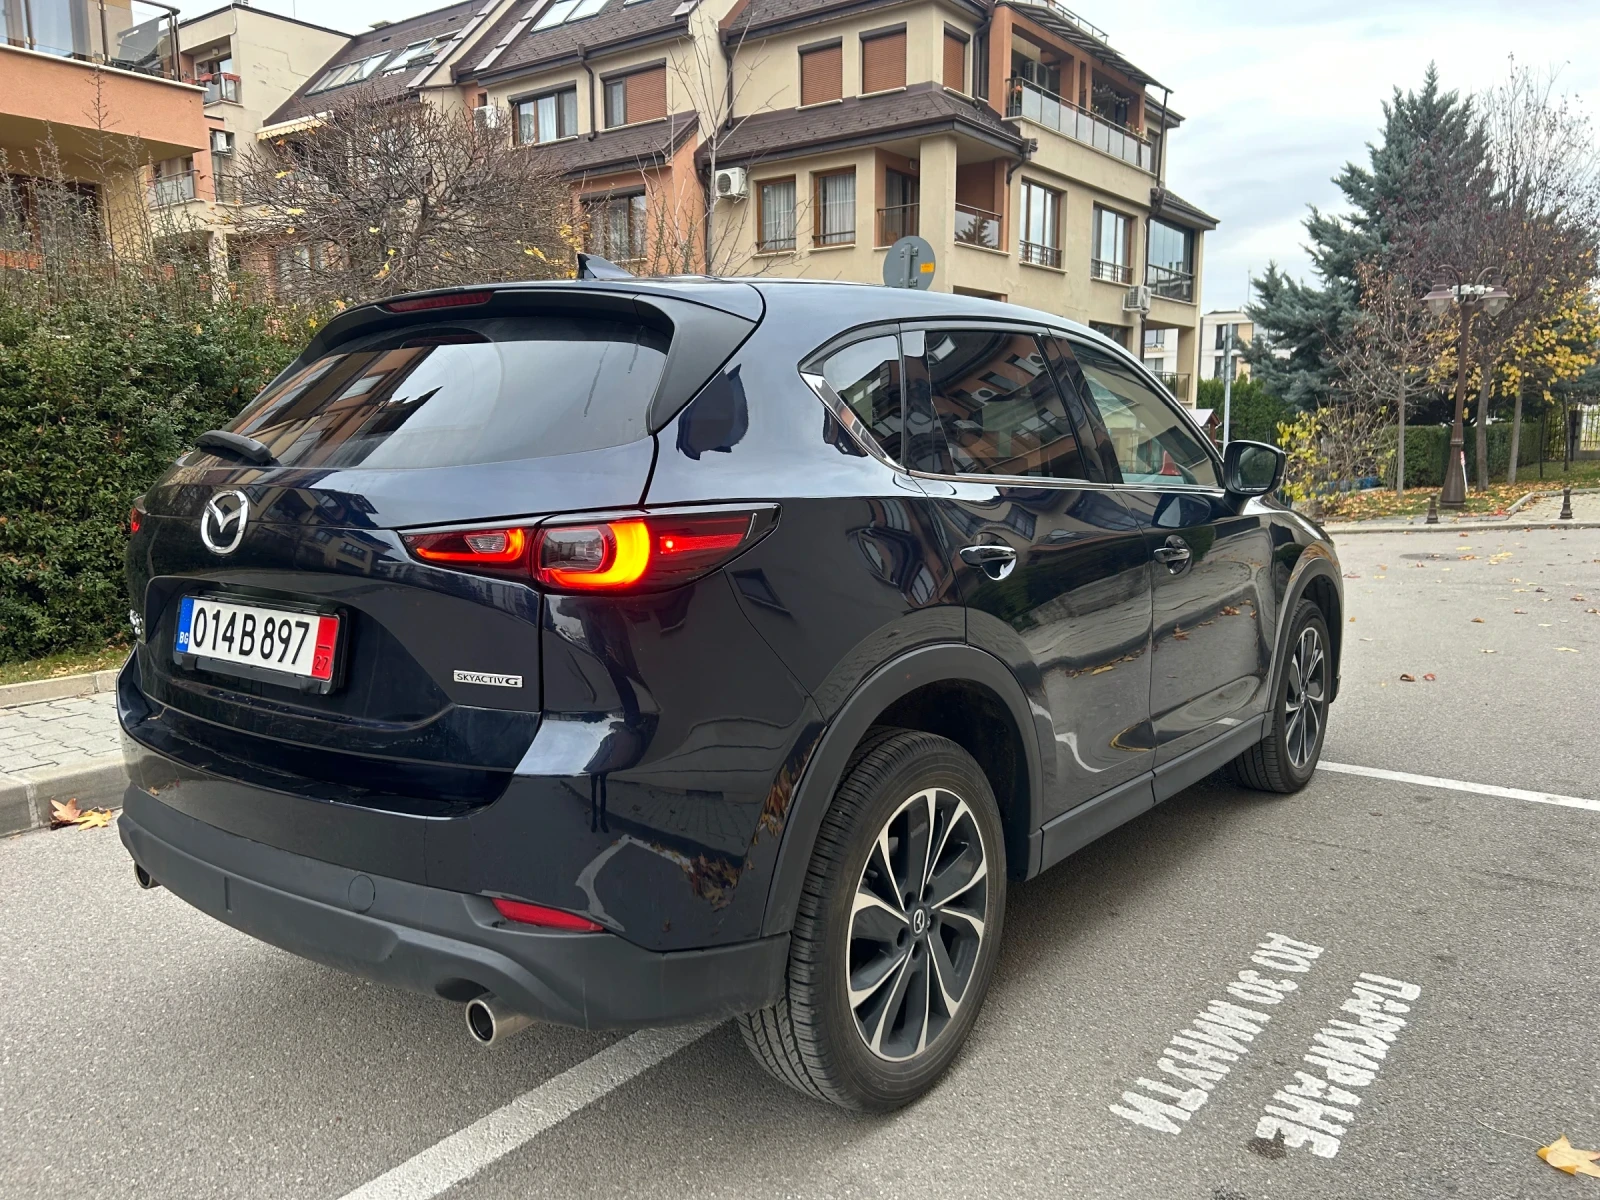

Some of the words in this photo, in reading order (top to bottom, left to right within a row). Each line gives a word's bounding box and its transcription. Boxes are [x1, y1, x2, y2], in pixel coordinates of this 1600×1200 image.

[178, 631, 189, 644] BG
[193, 606, 310, 665] 014B897
[314, 655, 329, 671] 27
[1250, 932, 1324, 972] ДО
[1226, 969, 1299, 1004] 30
[1109, 999, 1271, 1134] МИНУТИ
[1255, 972, 1421, 1158] ПАРКИРАНЕ
